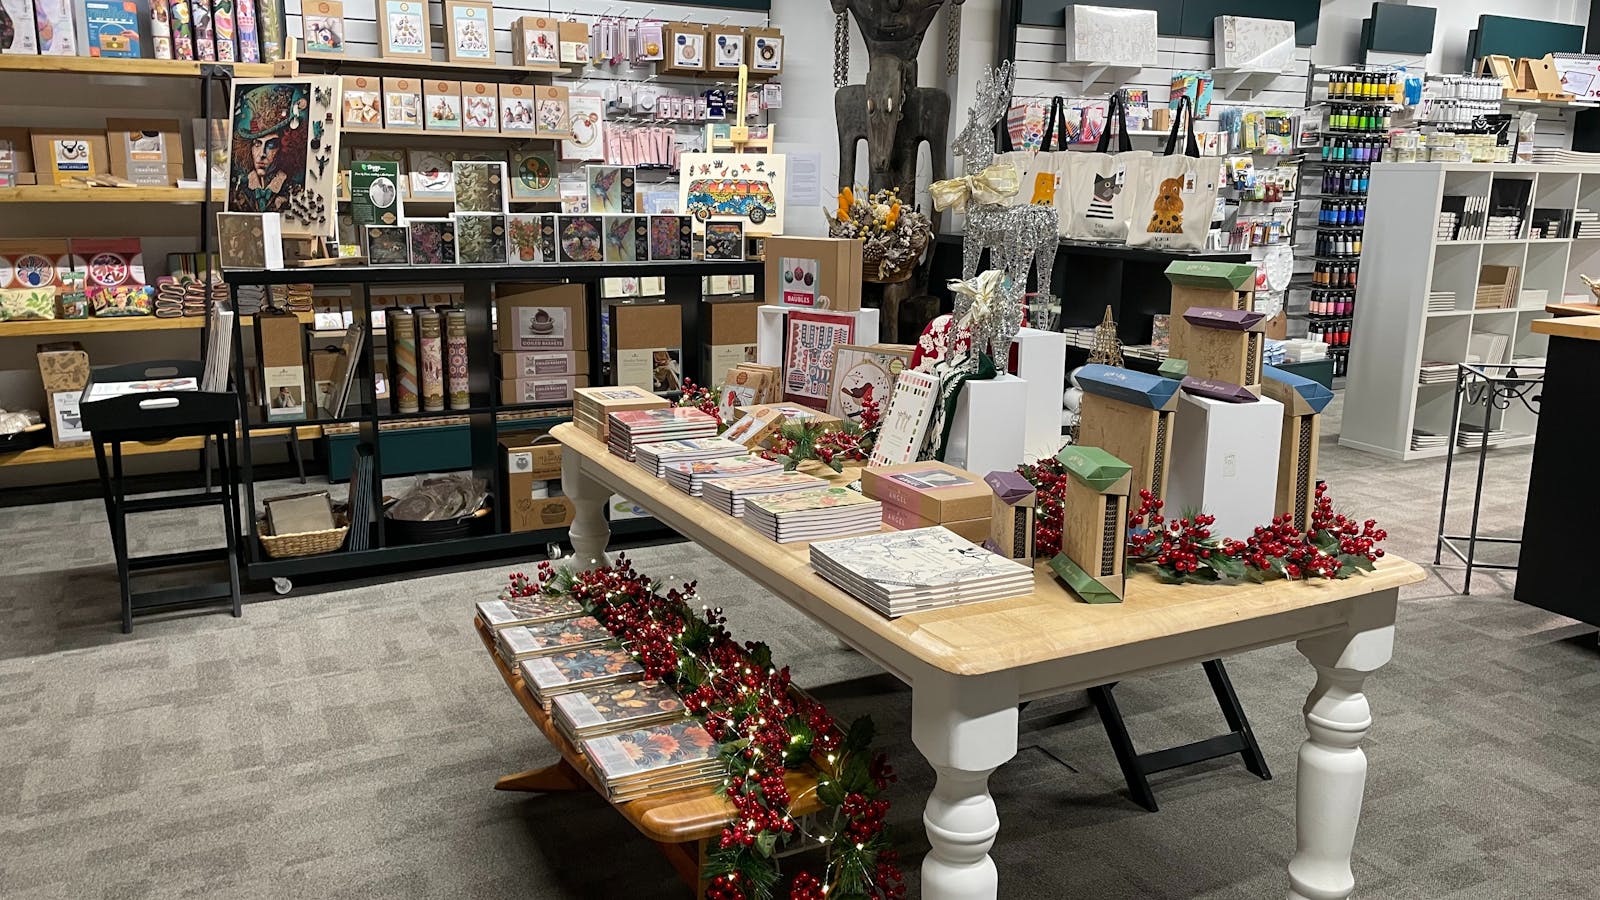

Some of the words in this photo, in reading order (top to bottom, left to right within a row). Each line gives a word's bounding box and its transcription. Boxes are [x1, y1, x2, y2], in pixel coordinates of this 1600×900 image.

[787, 295, 810, 304] BAUBLES
[889, 491, 907, 505] ANGEL
[888, 513, 905, 527] ANGEL
